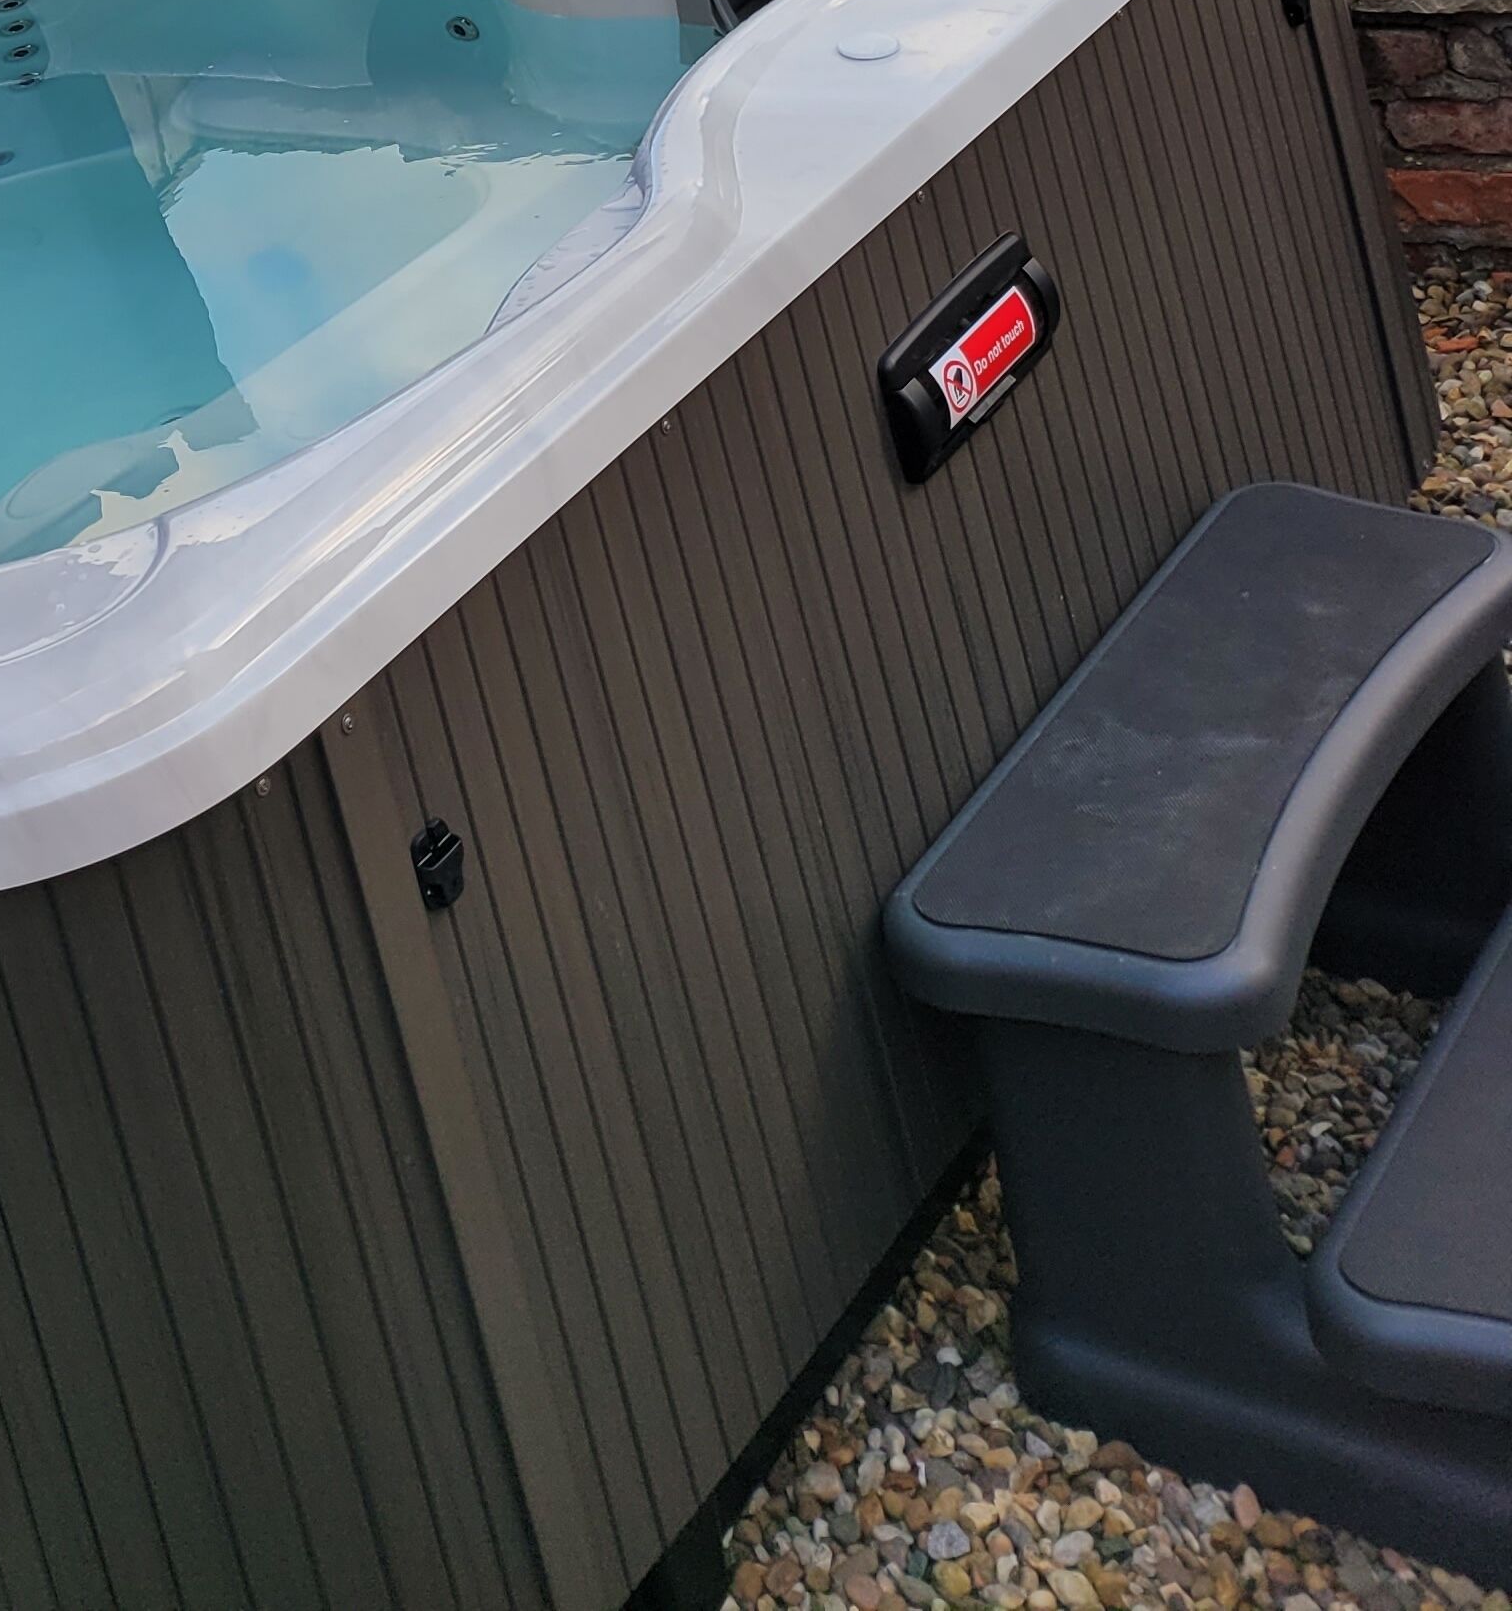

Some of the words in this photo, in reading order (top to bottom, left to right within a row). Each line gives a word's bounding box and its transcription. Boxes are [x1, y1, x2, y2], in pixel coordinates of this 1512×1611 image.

[974, 357, 988, 375] Do
[988, 340, 1003, 364] not
[1000, 319, 1024, 349] touch
